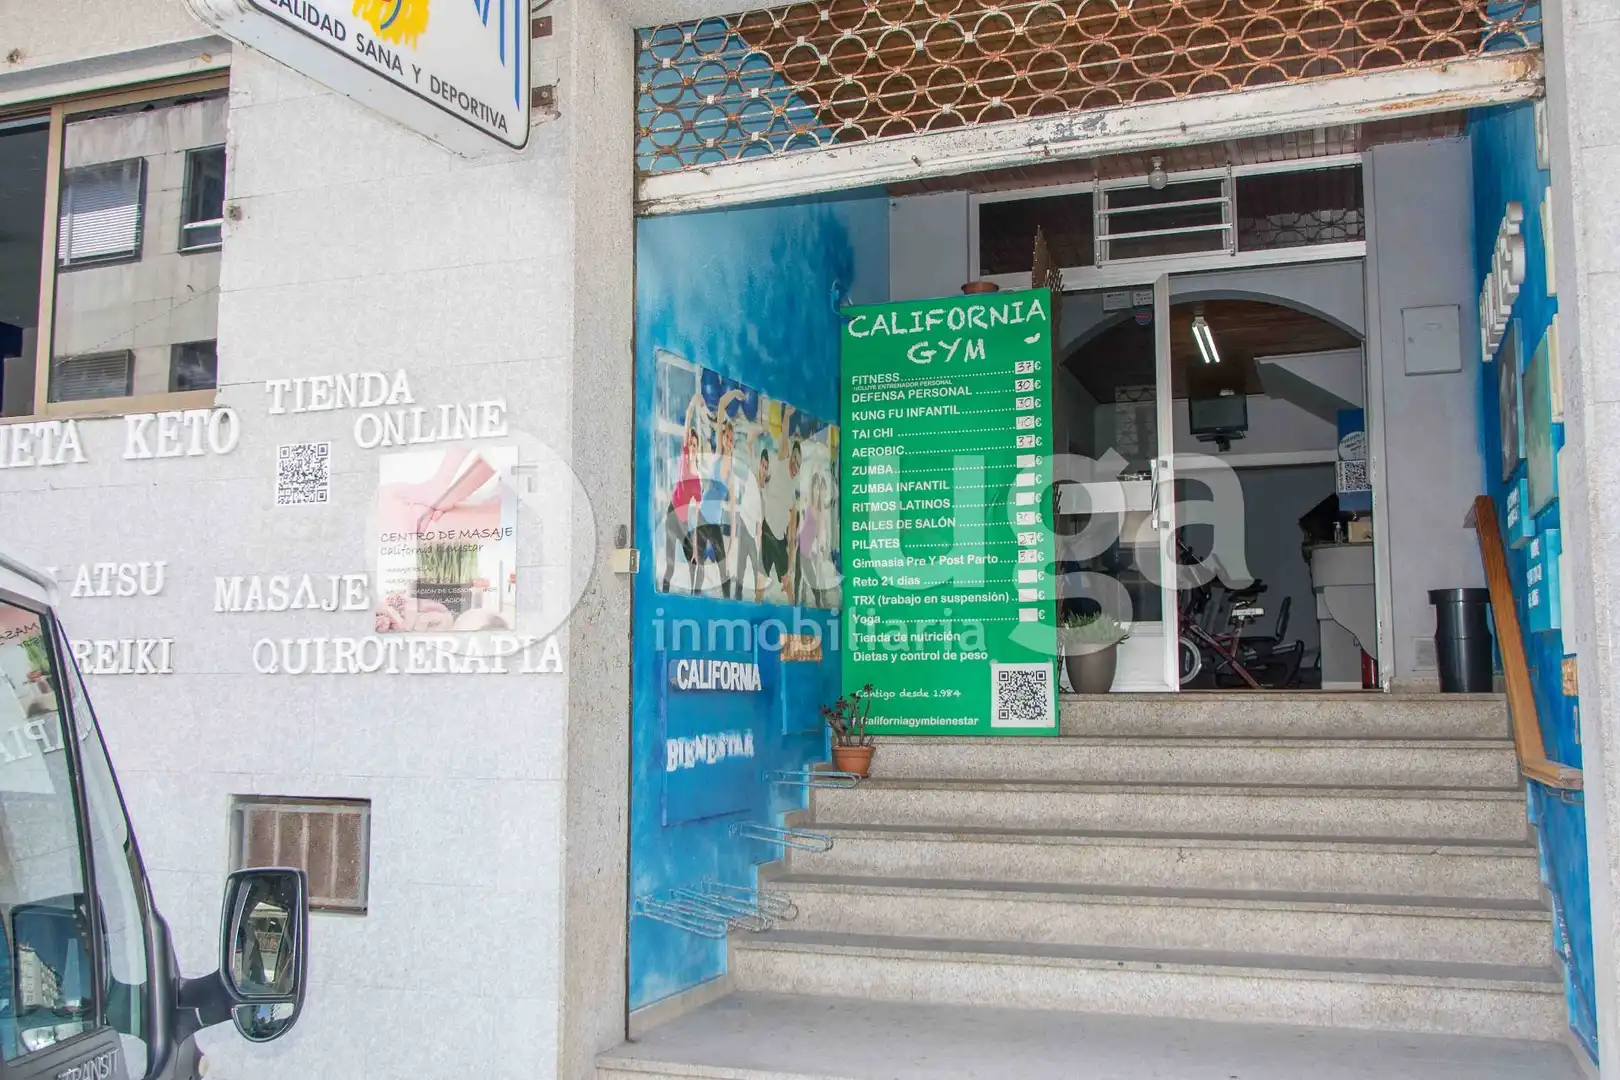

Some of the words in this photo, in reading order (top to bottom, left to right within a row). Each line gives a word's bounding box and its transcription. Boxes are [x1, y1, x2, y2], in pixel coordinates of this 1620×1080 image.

[269, 0, 347, 41] ALIDAD
[355, 33, 404, 76] SANA
[411, 63, 423, 85] Y
[430, 76, 509, 133] DEPORTIVA
[848, 299, 1047, 338] CALIFORNIA
[906, 337, 987, 364] GYM
[851, 373, 900, 386] FITNESS
[878, 382, 919, 390] ENTRENADOR
[919, 379, 953, 387] PERSONAL
[265, 369, 415, 415] TIENDA
[851, 389, 906, 403] DEFENSA
[908, 386, 972, 400] PERSONAL
[851, 409, 886, 421] KUNG
[888, 408, 904, 419] FU
[906, 405, 960, 418] INFANTIL
[353, 398, 508, 450] ONLINE
[123, 407, 240, 460] KETO
[851, 429, 870, 440] TAI
[873, 427, 893, 438] CHI
[851, 445, 905, 458] AEROBIC
[851, 464, 893, 476] ZUMBA
[851, 483, 893, 494] ZUMBA
[896, 480, 950, 492] INFANTIL
[851, 501, 897, 513] RITMOS
[899, 499, 951, 511] LATINOS
[851, 519, 894, 531] BAILES
[896, 518, 913, 529] DE
[915, 516, 956, 529] SALÓN
[380, 531, 435, 543] CENTRO
[438, 529, 456, 540] DE
[459, 527, 514, 541] MASAJE
[380, 542, 432, 556] California
[851, 538, 901, 550] PILATES
[852, 556, 904, 568] Gimnasia
[907, 556, 926, 566] Pre
[928, 556, 937, 565] Y
[939, 555, 965, 565] Post
[967, 554, 998, 565] Parto
[852, 576, 879, 586] Reto
[881, 576, 894, 586] 21
[213, 572, 370, 612] MASAJE
[852, 594, 876, 605] TRX
[878, 593, 921, 606] (trabajo
[923, 595, 938, 604] en
[940, 591, 1010, 606] suspensión)
[852, 614, 881, 626] Yoga
[852, 632, 891, 643] Tienda
[893, 632, 908, 642] de
[910, 630, 961, 642] nutrición
[70, 637, 174, 675] REIKI
[252, 634, 564, 675] QUIROTERAPIA
[853, 651, 889, 662] Dietas
[890, 653, 898, 664] y
[900, 650, 940, 661] control
[943, 651, 958, 661] de
[959, 651, 988, 663] peso
[676, 659, 761, 691] CALIFORNIA
[855, 688, 896, 701] Contigo
[899, 687, 929, 698] desde
[932, 688, 962, 698] 1.984
